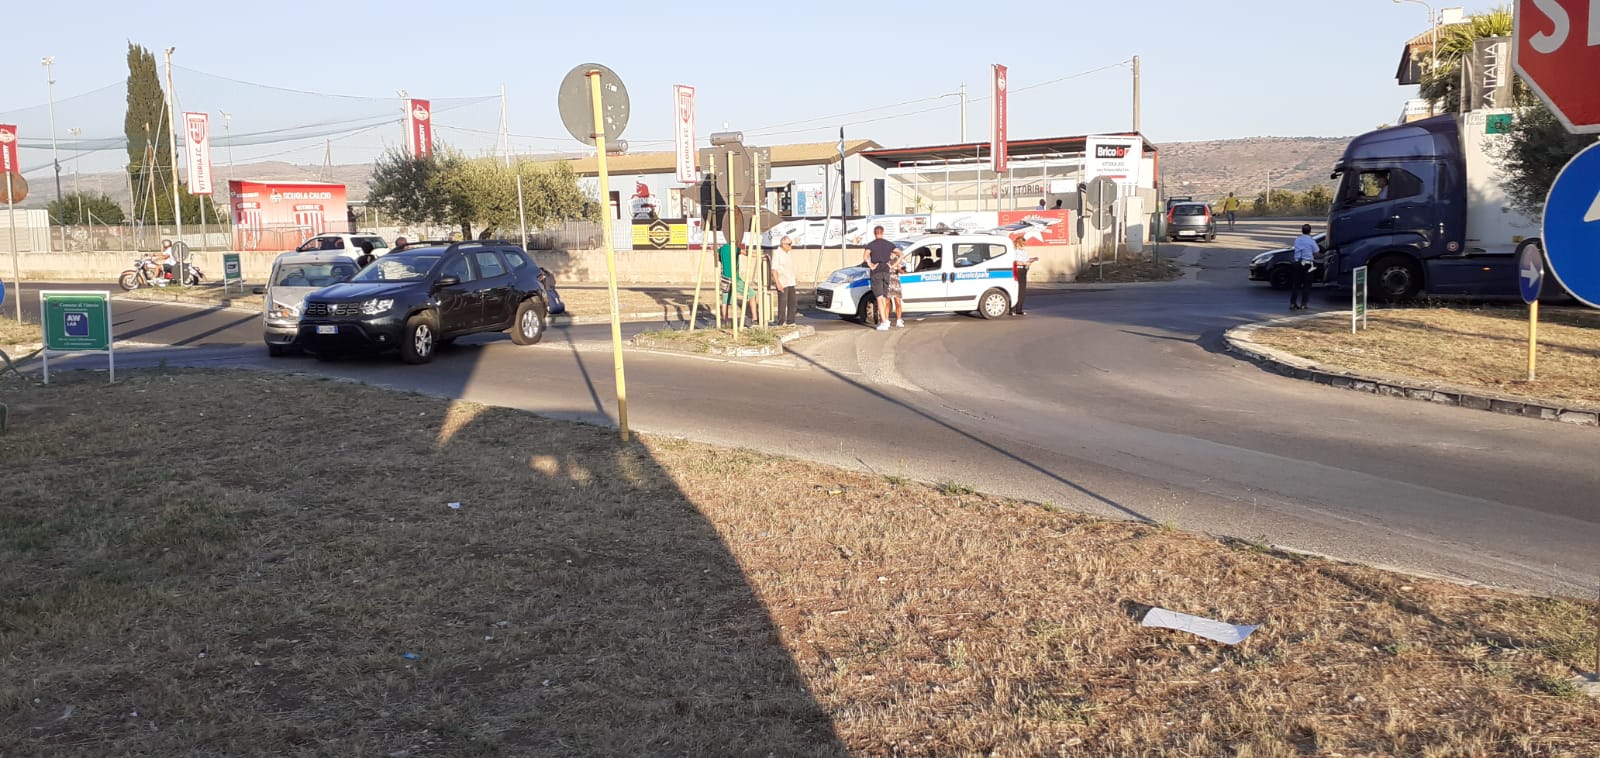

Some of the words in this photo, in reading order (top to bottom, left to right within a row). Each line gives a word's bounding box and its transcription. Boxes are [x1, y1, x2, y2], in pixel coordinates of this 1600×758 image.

[1528, 0, 1600, 54] S
[1005, 184, 1040, 196] VTTORIA
[282, 191, 308, 200] SCUOLA
[308, 192, 332, 200] CALCIO
[66, 314, 81, 322] AW
